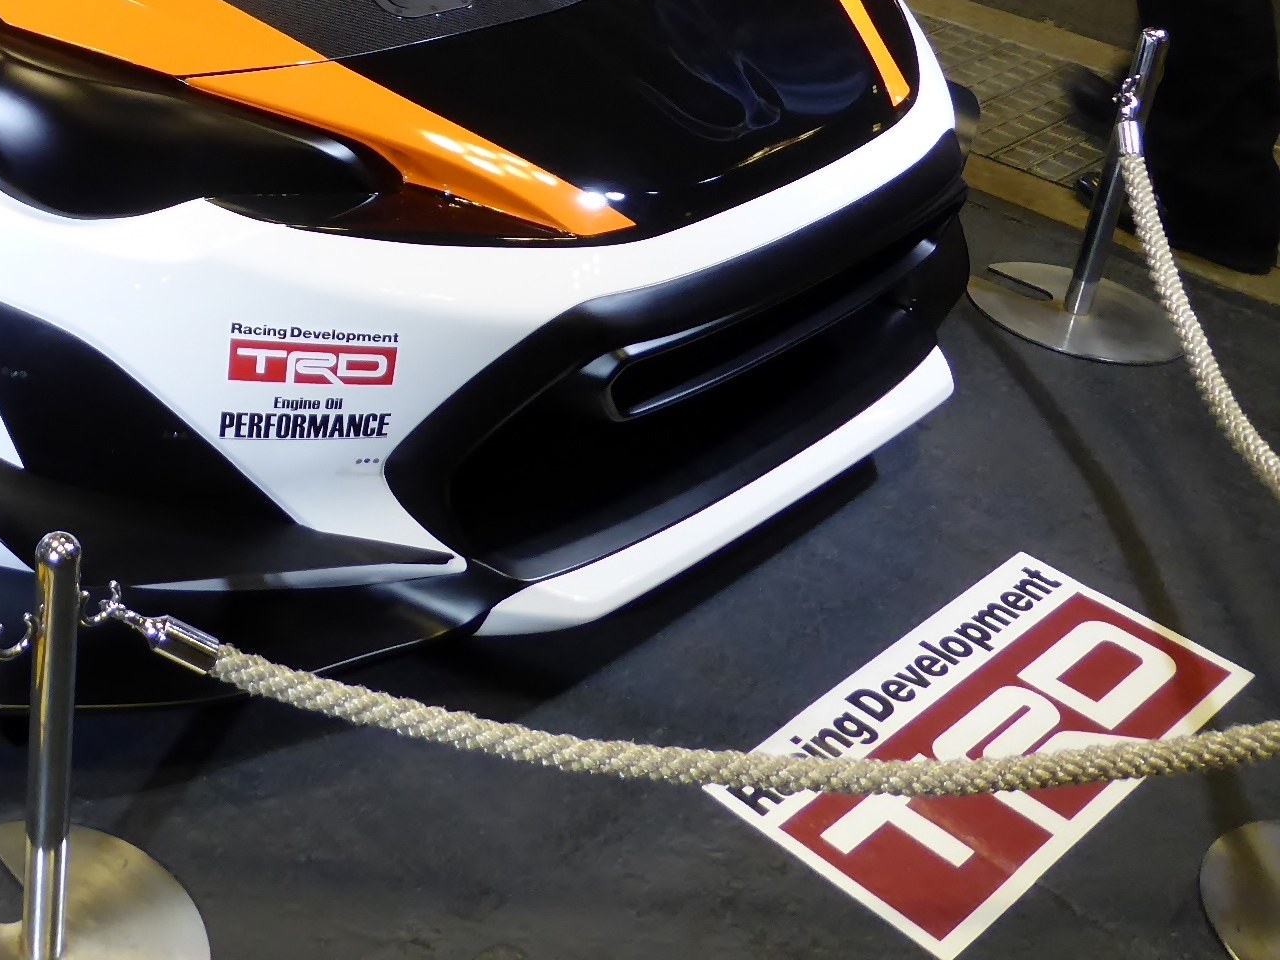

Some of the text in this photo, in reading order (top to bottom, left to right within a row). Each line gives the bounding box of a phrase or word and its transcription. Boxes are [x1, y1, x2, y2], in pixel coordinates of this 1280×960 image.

[230, 322, 399, 343] Racing Development
[235, 345, 390, 385] TRD
[273, 396, 343, 411] Engine Oil
[219, 411, 392, 439] PERFORMANCE
[725, 566, 1062, 817] Ring Development
[820, 620, 1178, 869] TRD
